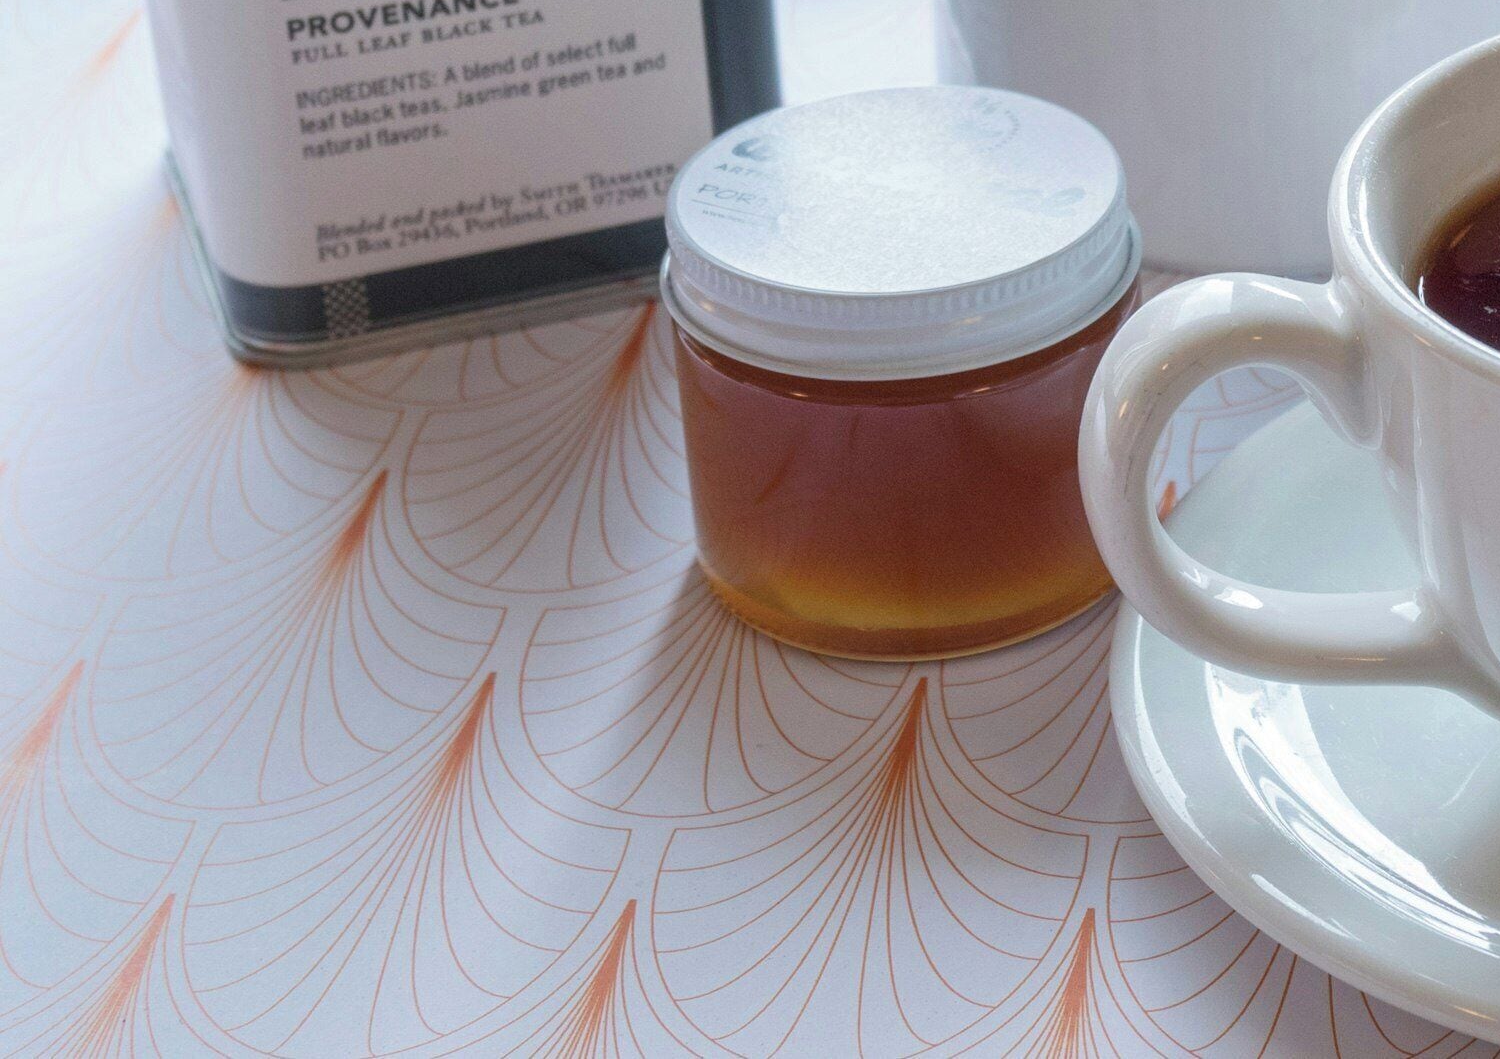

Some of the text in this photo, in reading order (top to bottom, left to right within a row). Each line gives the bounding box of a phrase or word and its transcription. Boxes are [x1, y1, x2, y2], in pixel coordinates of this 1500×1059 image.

[291, 8, 545, 65] FULL LEAF BLACK TEA
[296, 32, 637, 110] INGREDIENTS: A blend of select full
[300, 111, 336, 135] leaf
[342, 105, 394, 128] black
[455, 81, 532, 110] Jasmine
[538, 70, 592, 97] green
[597, 62, 628, 82] tea
[633, 53, 667, 75] and
[303, 133, 372, 161] natural
[316, 212, 386, 240] Blended
[555, 194, 588, 217] OR
